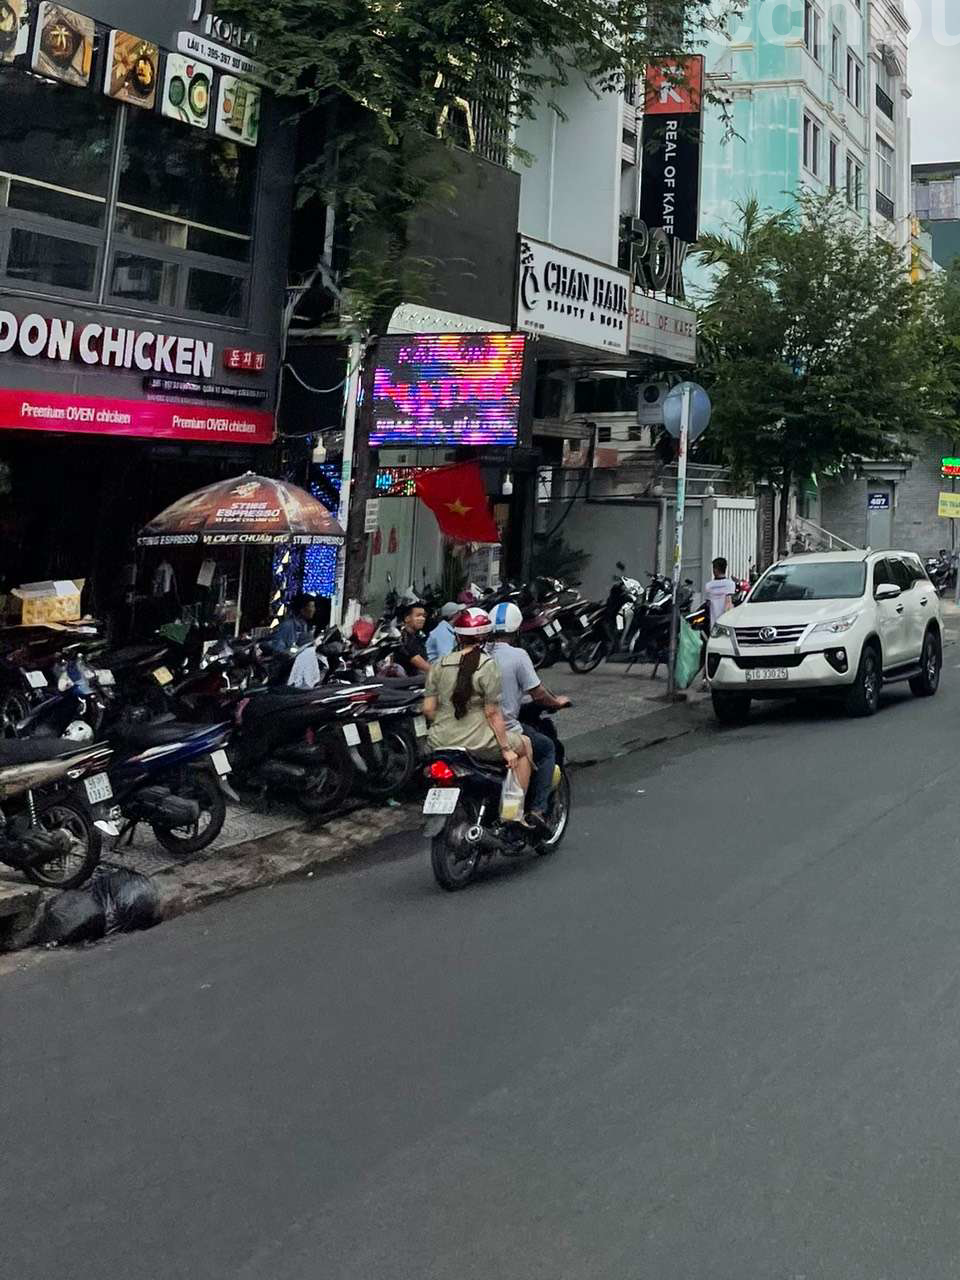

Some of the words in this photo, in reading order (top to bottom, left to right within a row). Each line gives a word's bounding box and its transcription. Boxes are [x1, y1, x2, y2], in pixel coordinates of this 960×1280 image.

[665, 121, 678, 162] REAL
[664, 165, 677, 188] OF
[662, 193, 676, 235] KAFE
[544, 261, 590, 302] CHAN
[592, 276, 629, 316] HAIR
[547, 300, 585, 320] BEAUTY
[600, 315, 624, 331] MORE
[657, 315, 668, 331] OF
[0, 310, 74, 361] DON
[79, 323, 214, 378] CHICKEN
[66, 406, 95, 422] OVEN
[172, 415, 206, 430] Premium
[206, 418, 228, 432] OVEN
[215, 508, 280, 517] ESPRESSO
